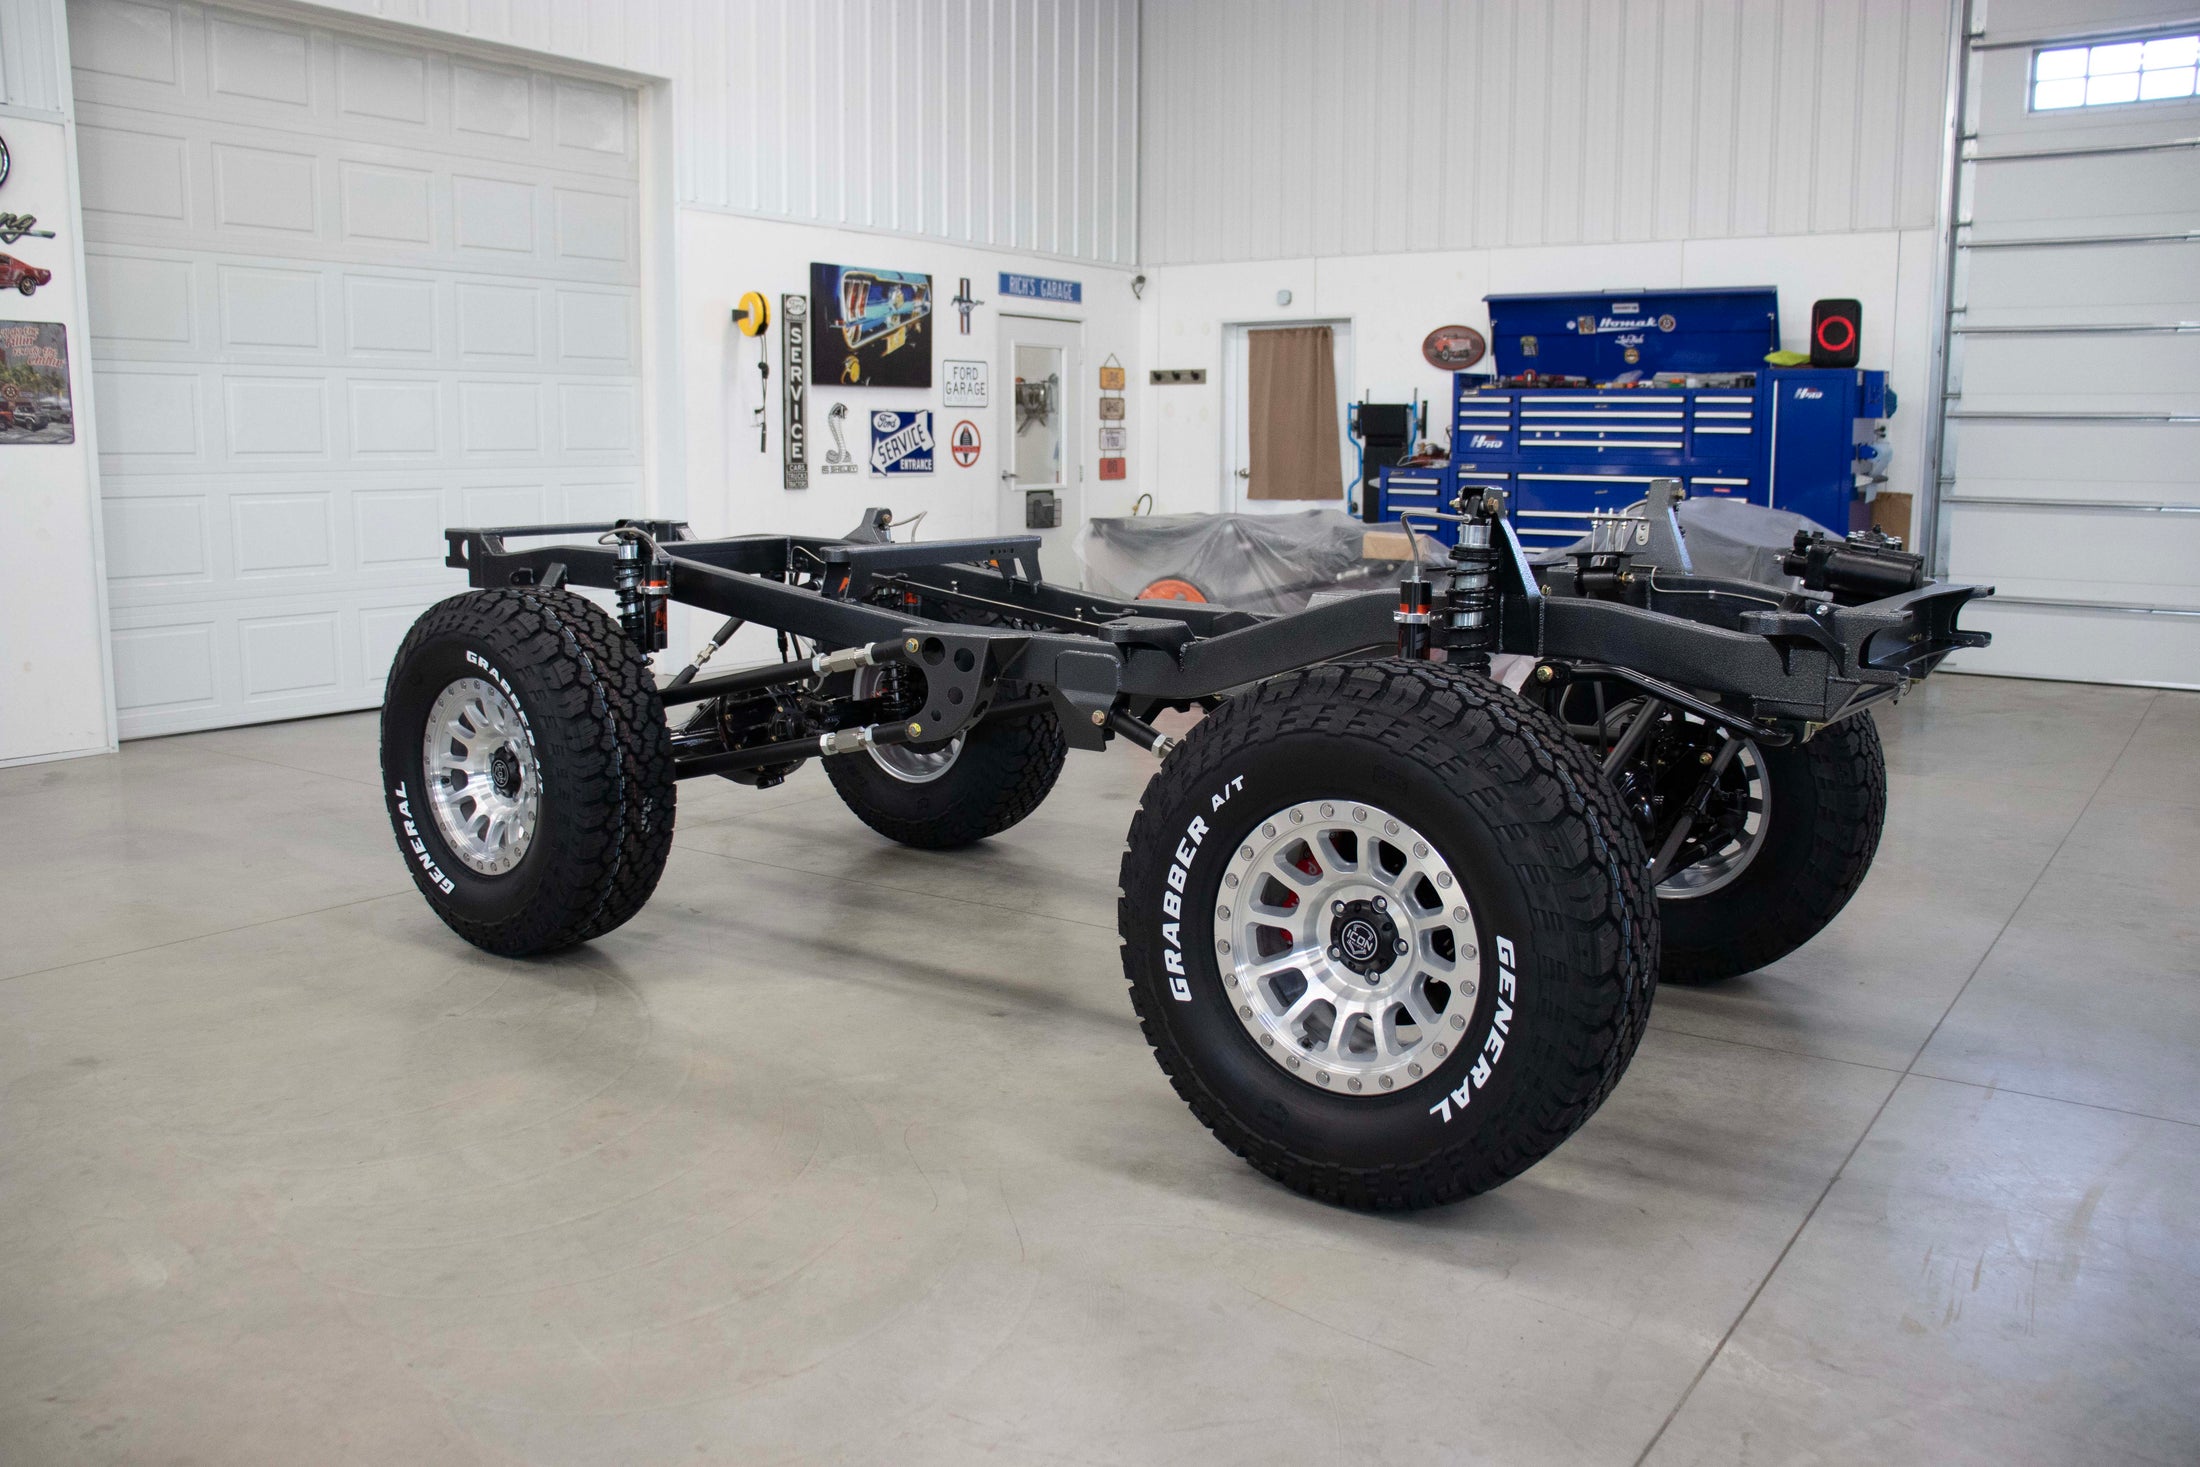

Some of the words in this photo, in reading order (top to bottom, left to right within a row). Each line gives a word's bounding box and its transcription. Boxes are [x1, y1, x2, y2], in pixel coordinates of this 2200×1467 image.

[1008, 275, 1036, 296] RICH'S
[1041, 279, 1073, 300] GARAGE
[1598, 316, 1657, 330] Homak
[953, 367, 978, 380] FORD
[790, 327, 803, 459] SERVICE
[946, 382, 986, 396] GARAGE
[877, 413, 897, 428] Ford
[877, 424, 925, 464] SERVICE
[900, 458, 933, 471] ENTRANCE
[395, 780, 456, 895] GENERAL
[1162, 815, 1209, 1001] GRABBER
[1211, 774, 1244, 812] A/T
[1347, 929, 1373, 951] ICON
[1429, 935, 1516, 1123] GENERAL
